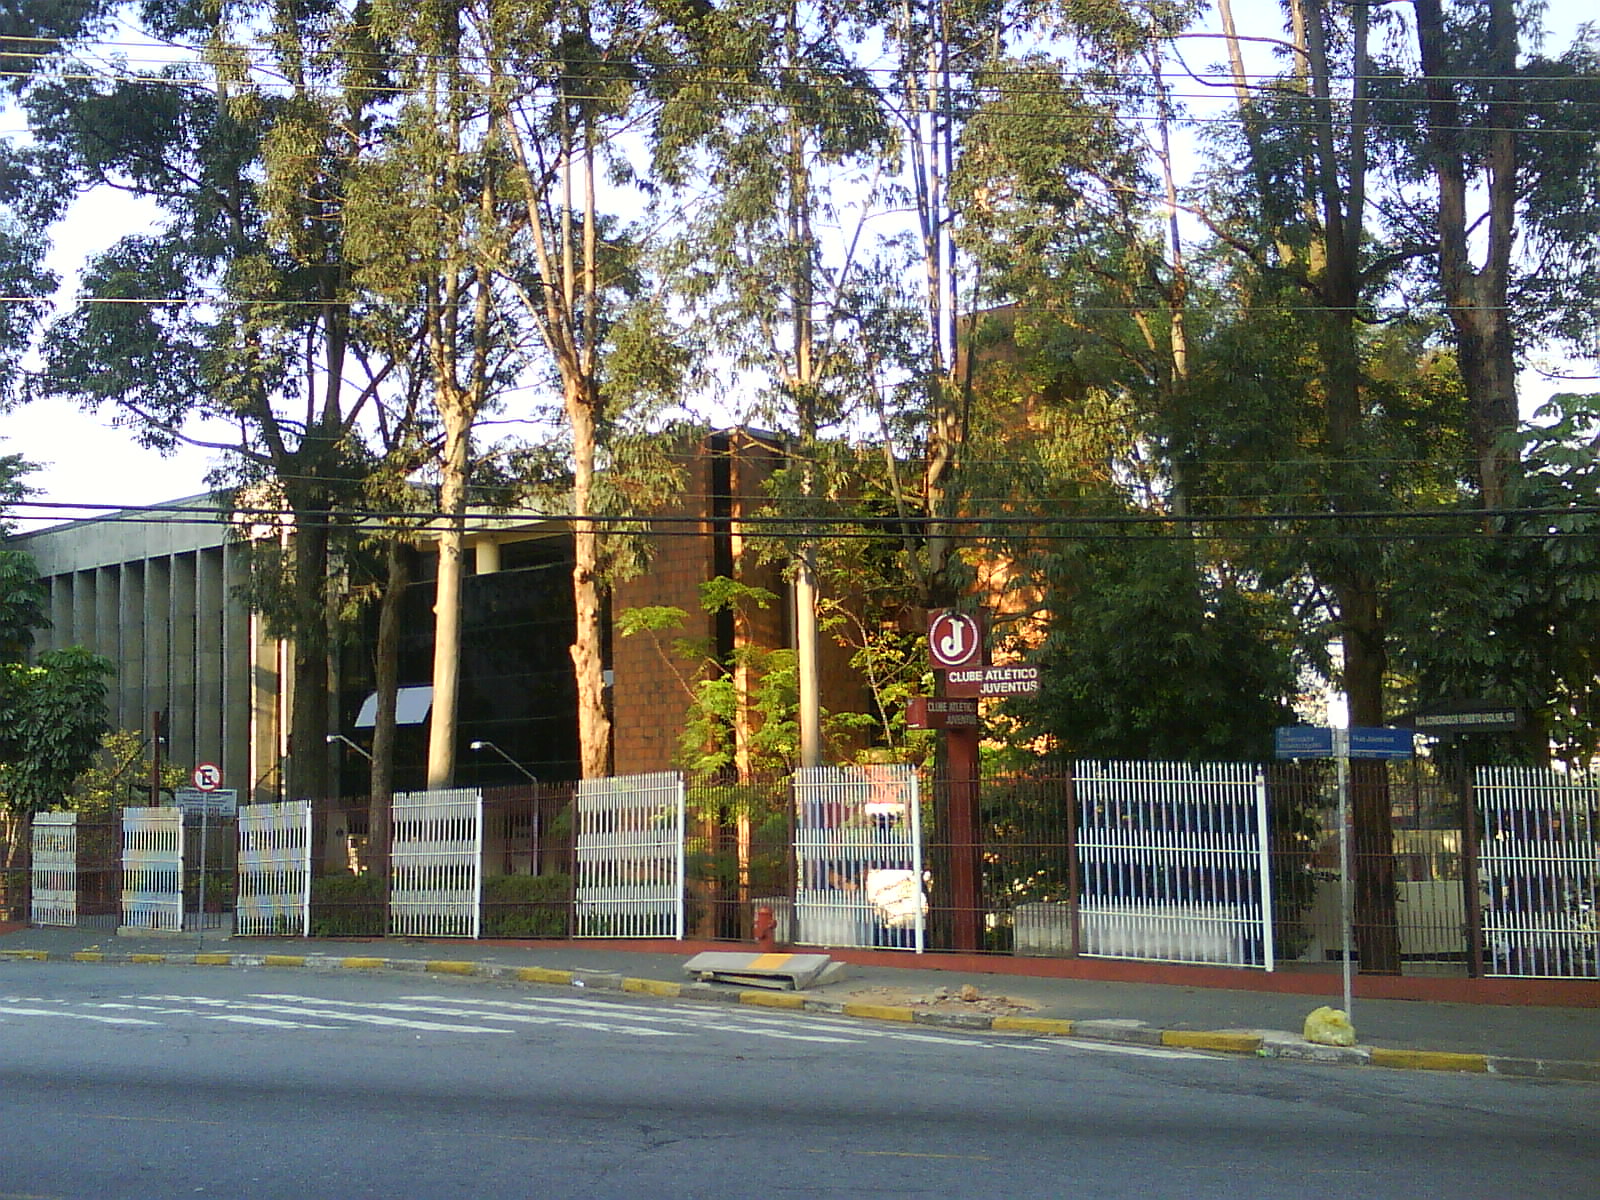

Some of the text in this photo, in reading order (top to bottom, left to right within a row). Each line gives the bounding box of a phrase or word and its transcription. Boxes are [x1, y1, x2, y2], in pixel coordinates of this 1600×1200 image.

[940, 617, 965, 658] J
[948, 671, 983, 683] CLUBE
[980, 681, 1038, 694] JUVENTUS
[202, 769, 213, 785] E
